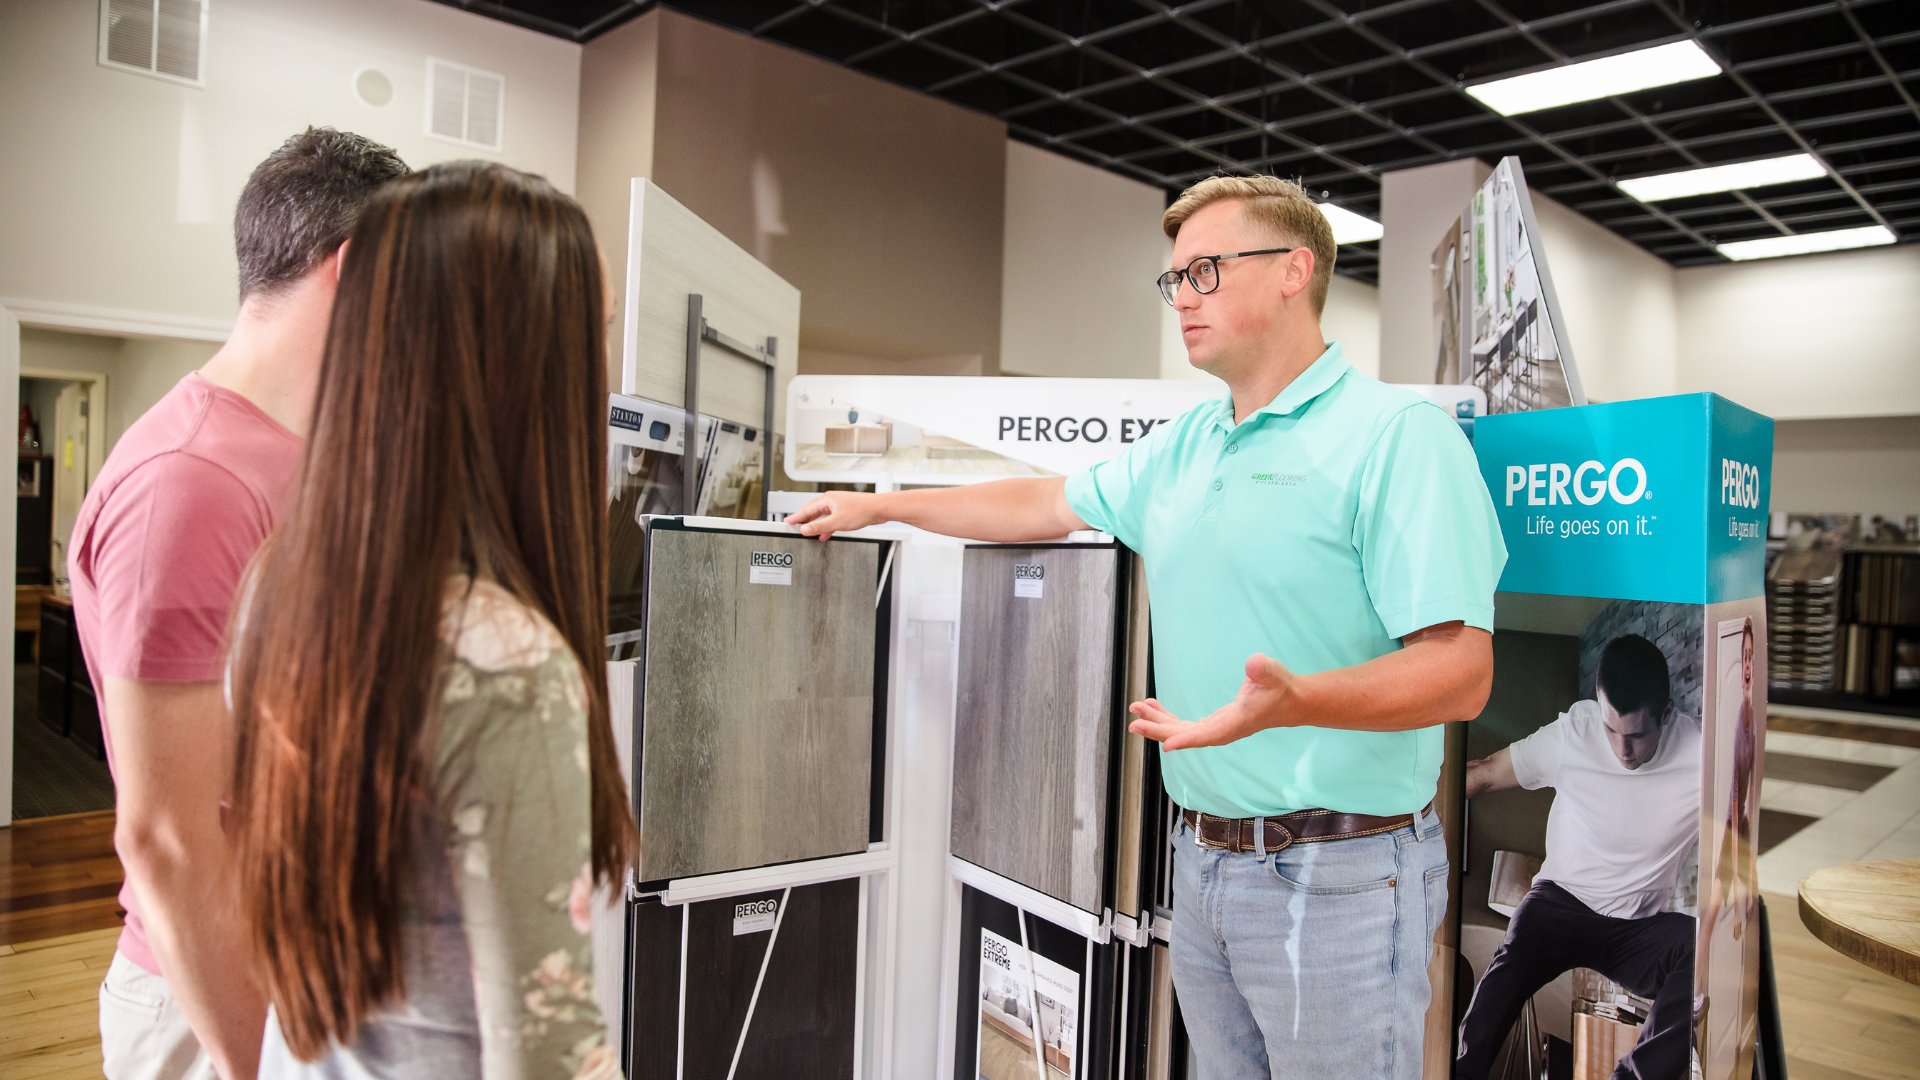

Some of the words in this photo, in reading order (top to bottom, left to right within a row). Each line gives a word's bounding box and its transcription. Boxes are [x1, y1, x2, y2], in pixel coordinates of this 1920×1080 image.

[612, 408, 642, 424] STANTON
[998, 416, 1108, 443] PERGO
[1722, 457, 1760, 510] PERGO
[1526, 515, 1555, 535] Life
[1560, 519, 1600, 539] goes
[1606, 519, 1629, 536] on
[753, 552, 793, 566] PERGO
[1015, 564, 1042, 578] PERGO
[736, 900, 776, 918] PERGO
[983, 936, 1008, 957] PERGO
[983, 947, 1011, 971] EXTREME
